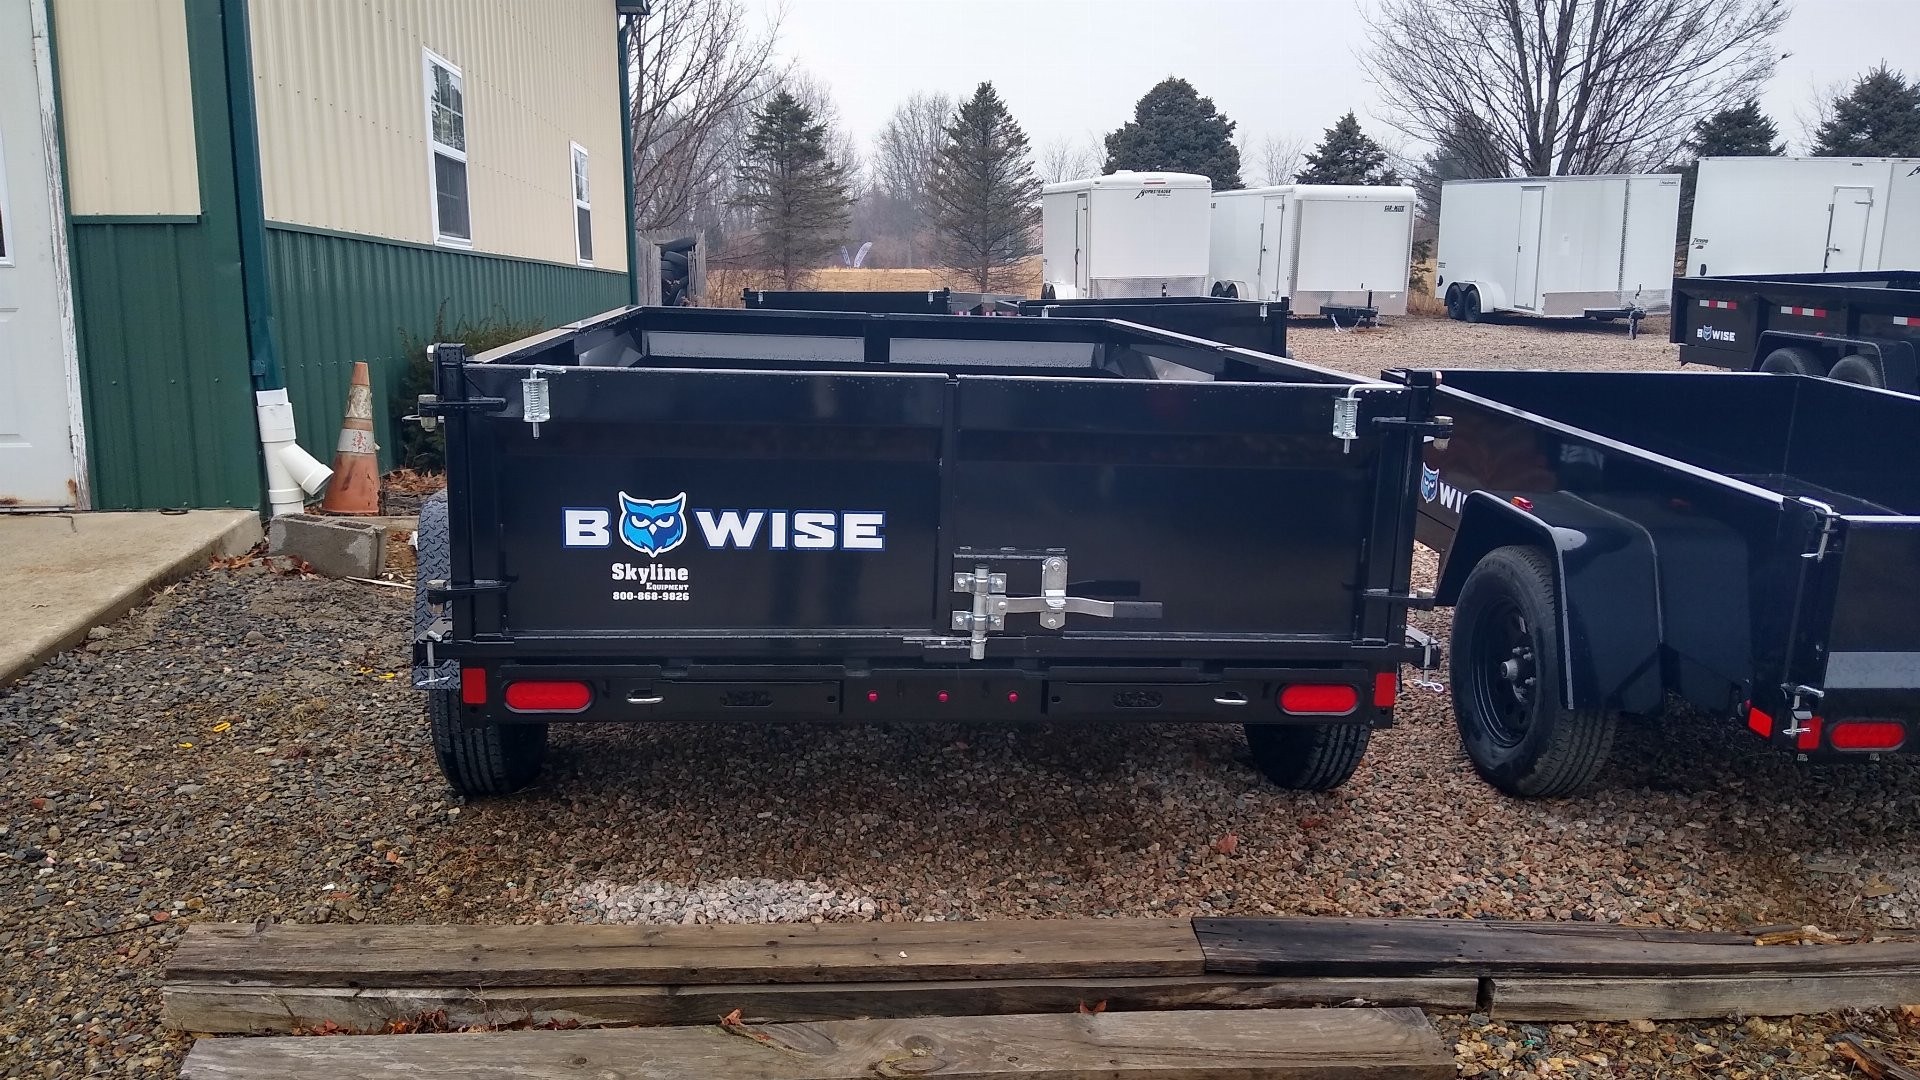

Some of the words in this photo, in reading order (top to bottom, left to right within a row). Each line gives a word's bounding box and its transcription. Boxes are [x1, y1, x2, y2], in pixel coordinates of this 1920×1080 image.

[611, 562, 689, 585] Skyline
[645, 582, 690, 591] EQUIPMENT
[612, 591, 690, 601] 800-868-9826
